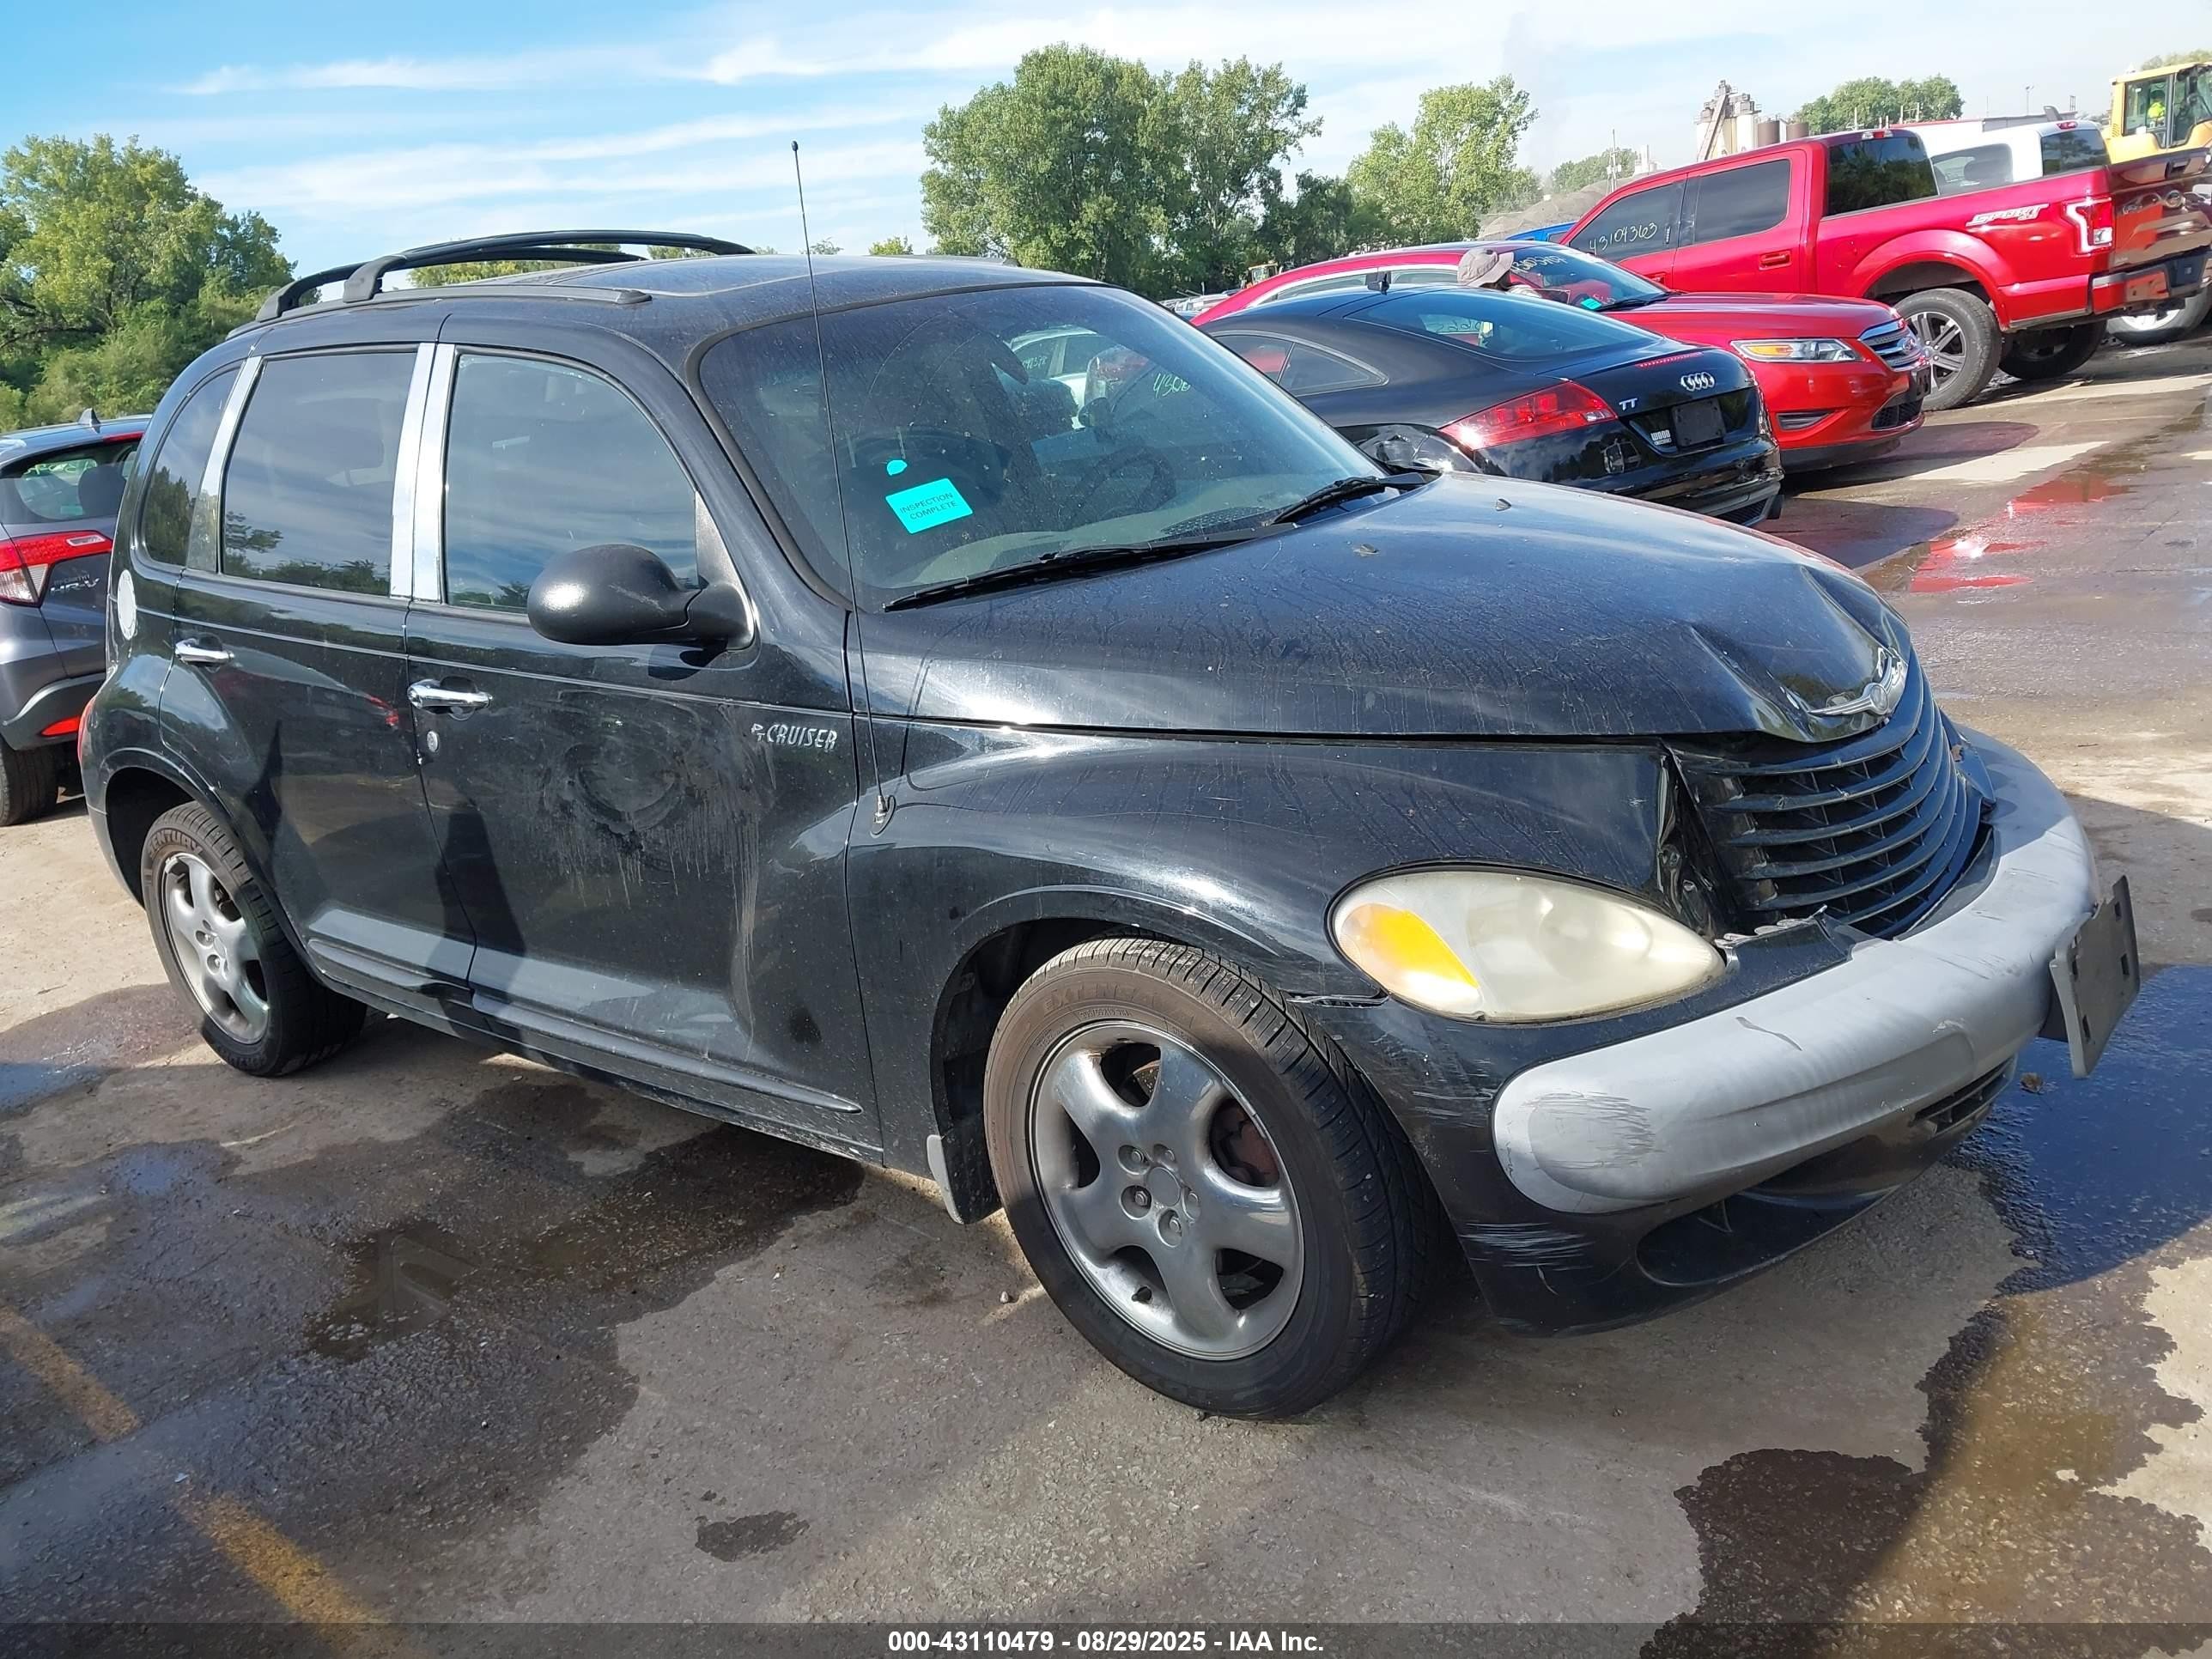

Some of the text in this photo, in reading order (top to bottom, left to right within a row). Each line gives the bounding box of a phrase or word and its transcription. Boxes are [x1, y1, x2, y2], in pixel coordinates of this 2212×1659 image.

[1589, 222, 1658, 256] 43104363
[1619, 398, 1638, 410] TT
[899, 492, 954, 514] INSPECTION
[909, 500, 958, 520] COMPLETE
[767, 723, 838, 750] CRUISER
